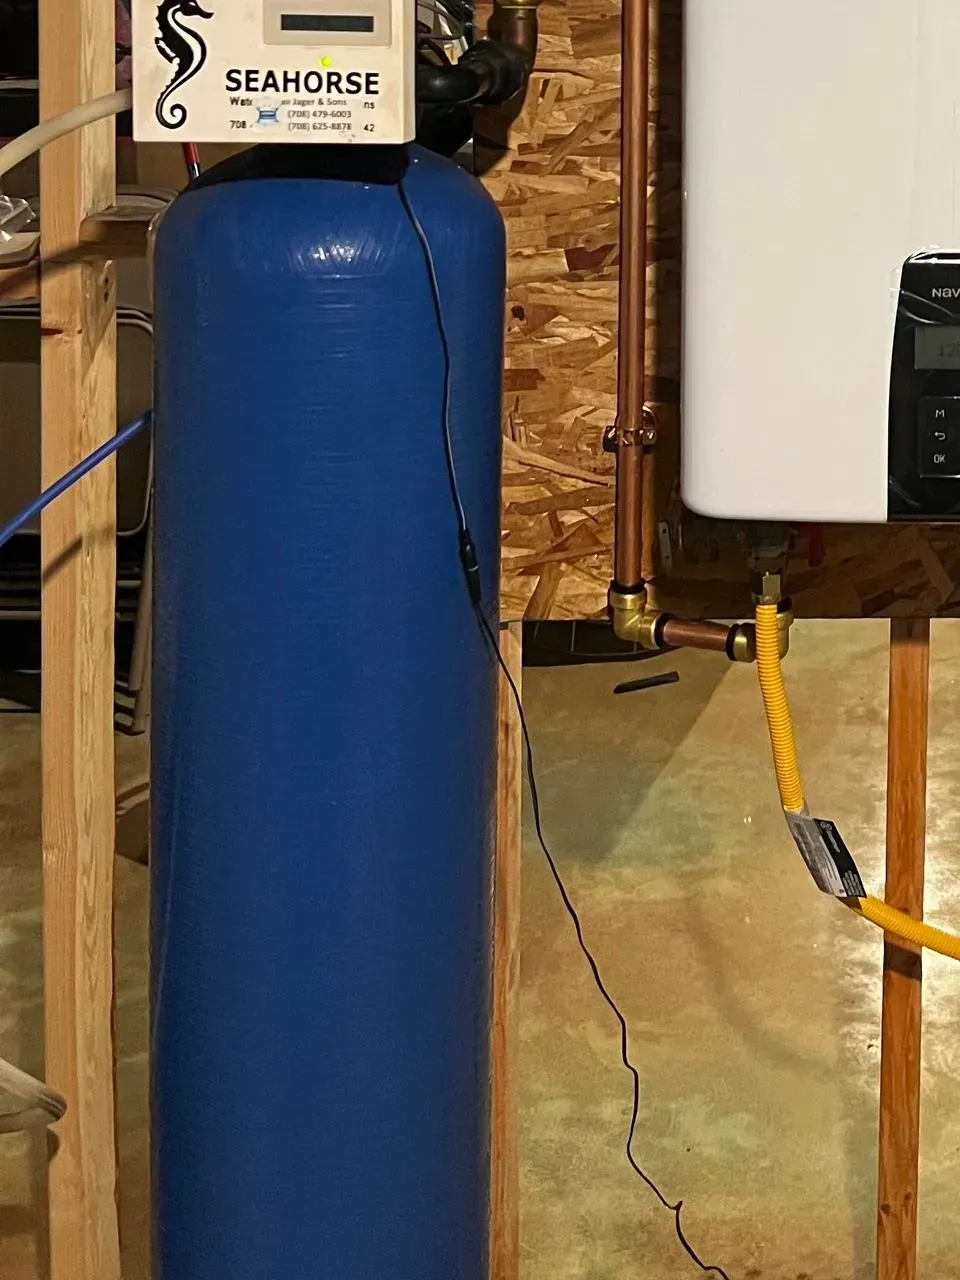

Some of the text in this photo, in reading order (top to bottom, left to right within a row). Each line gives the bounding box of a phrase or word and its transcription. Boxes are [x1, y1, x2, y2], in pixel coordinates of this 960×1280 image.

[225, 69, 380, 95] SEAHORSE
[292, 98, 315, 107] Jager
[327, 98, 347, 106] Sons
[230, 120, 247, 129] 708
[935, 409, 945, 418] M
[934, 454, 946, 464] OK
